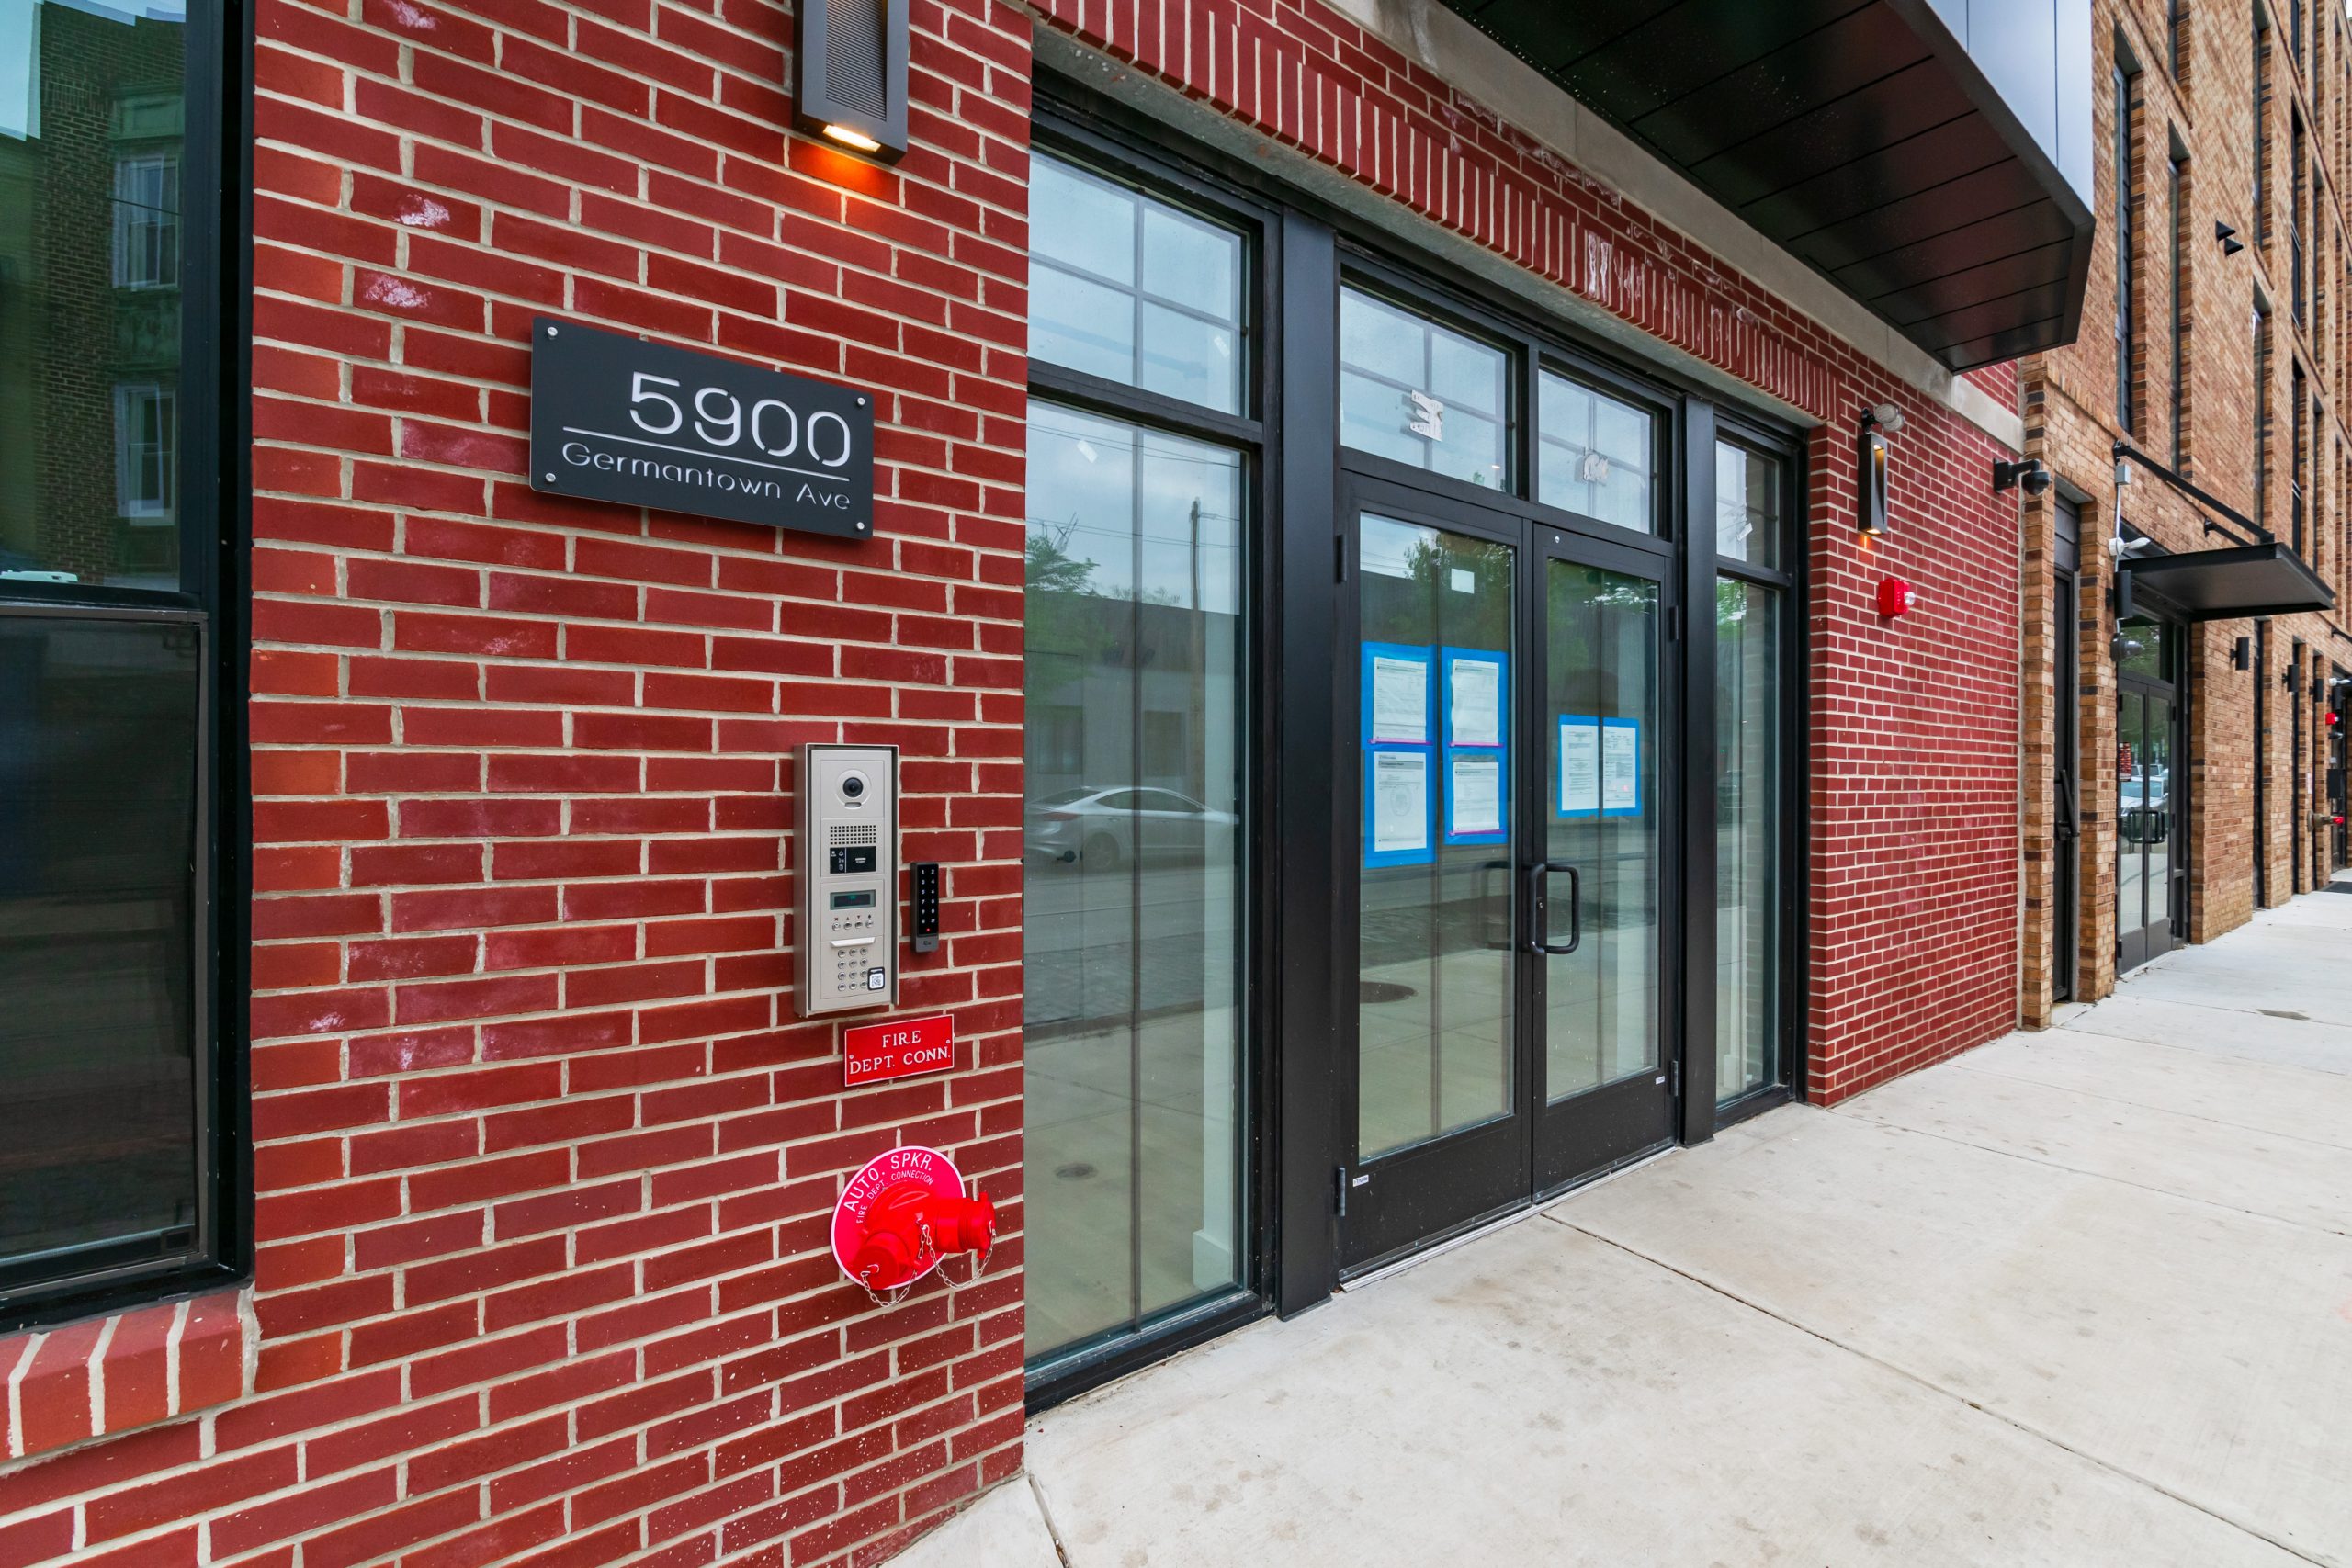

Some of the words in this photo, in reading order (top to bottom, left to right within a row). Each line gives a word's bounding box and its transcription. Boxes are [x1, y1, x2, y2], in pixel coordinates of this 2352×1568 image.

[630, 371, 851, 467] 5900
[562, 442, 781, 500] Germantown
[796, 483, 851, 510] Ave
[849, 1055, 896, 1075] DEPT.
[903, 1045, 951, 1066] CONN.
[882, 1030, 922, 1048] FIRE
[843, 1168, 886, 1213] AUTO.
[890, 1152, 933, 1171] SPKR.
[855, 1204, 868, 1224] FIRE
[866, 1179, 888, 1201] DEPT.
[891, 1169, 934, 1186] CONNECTION
